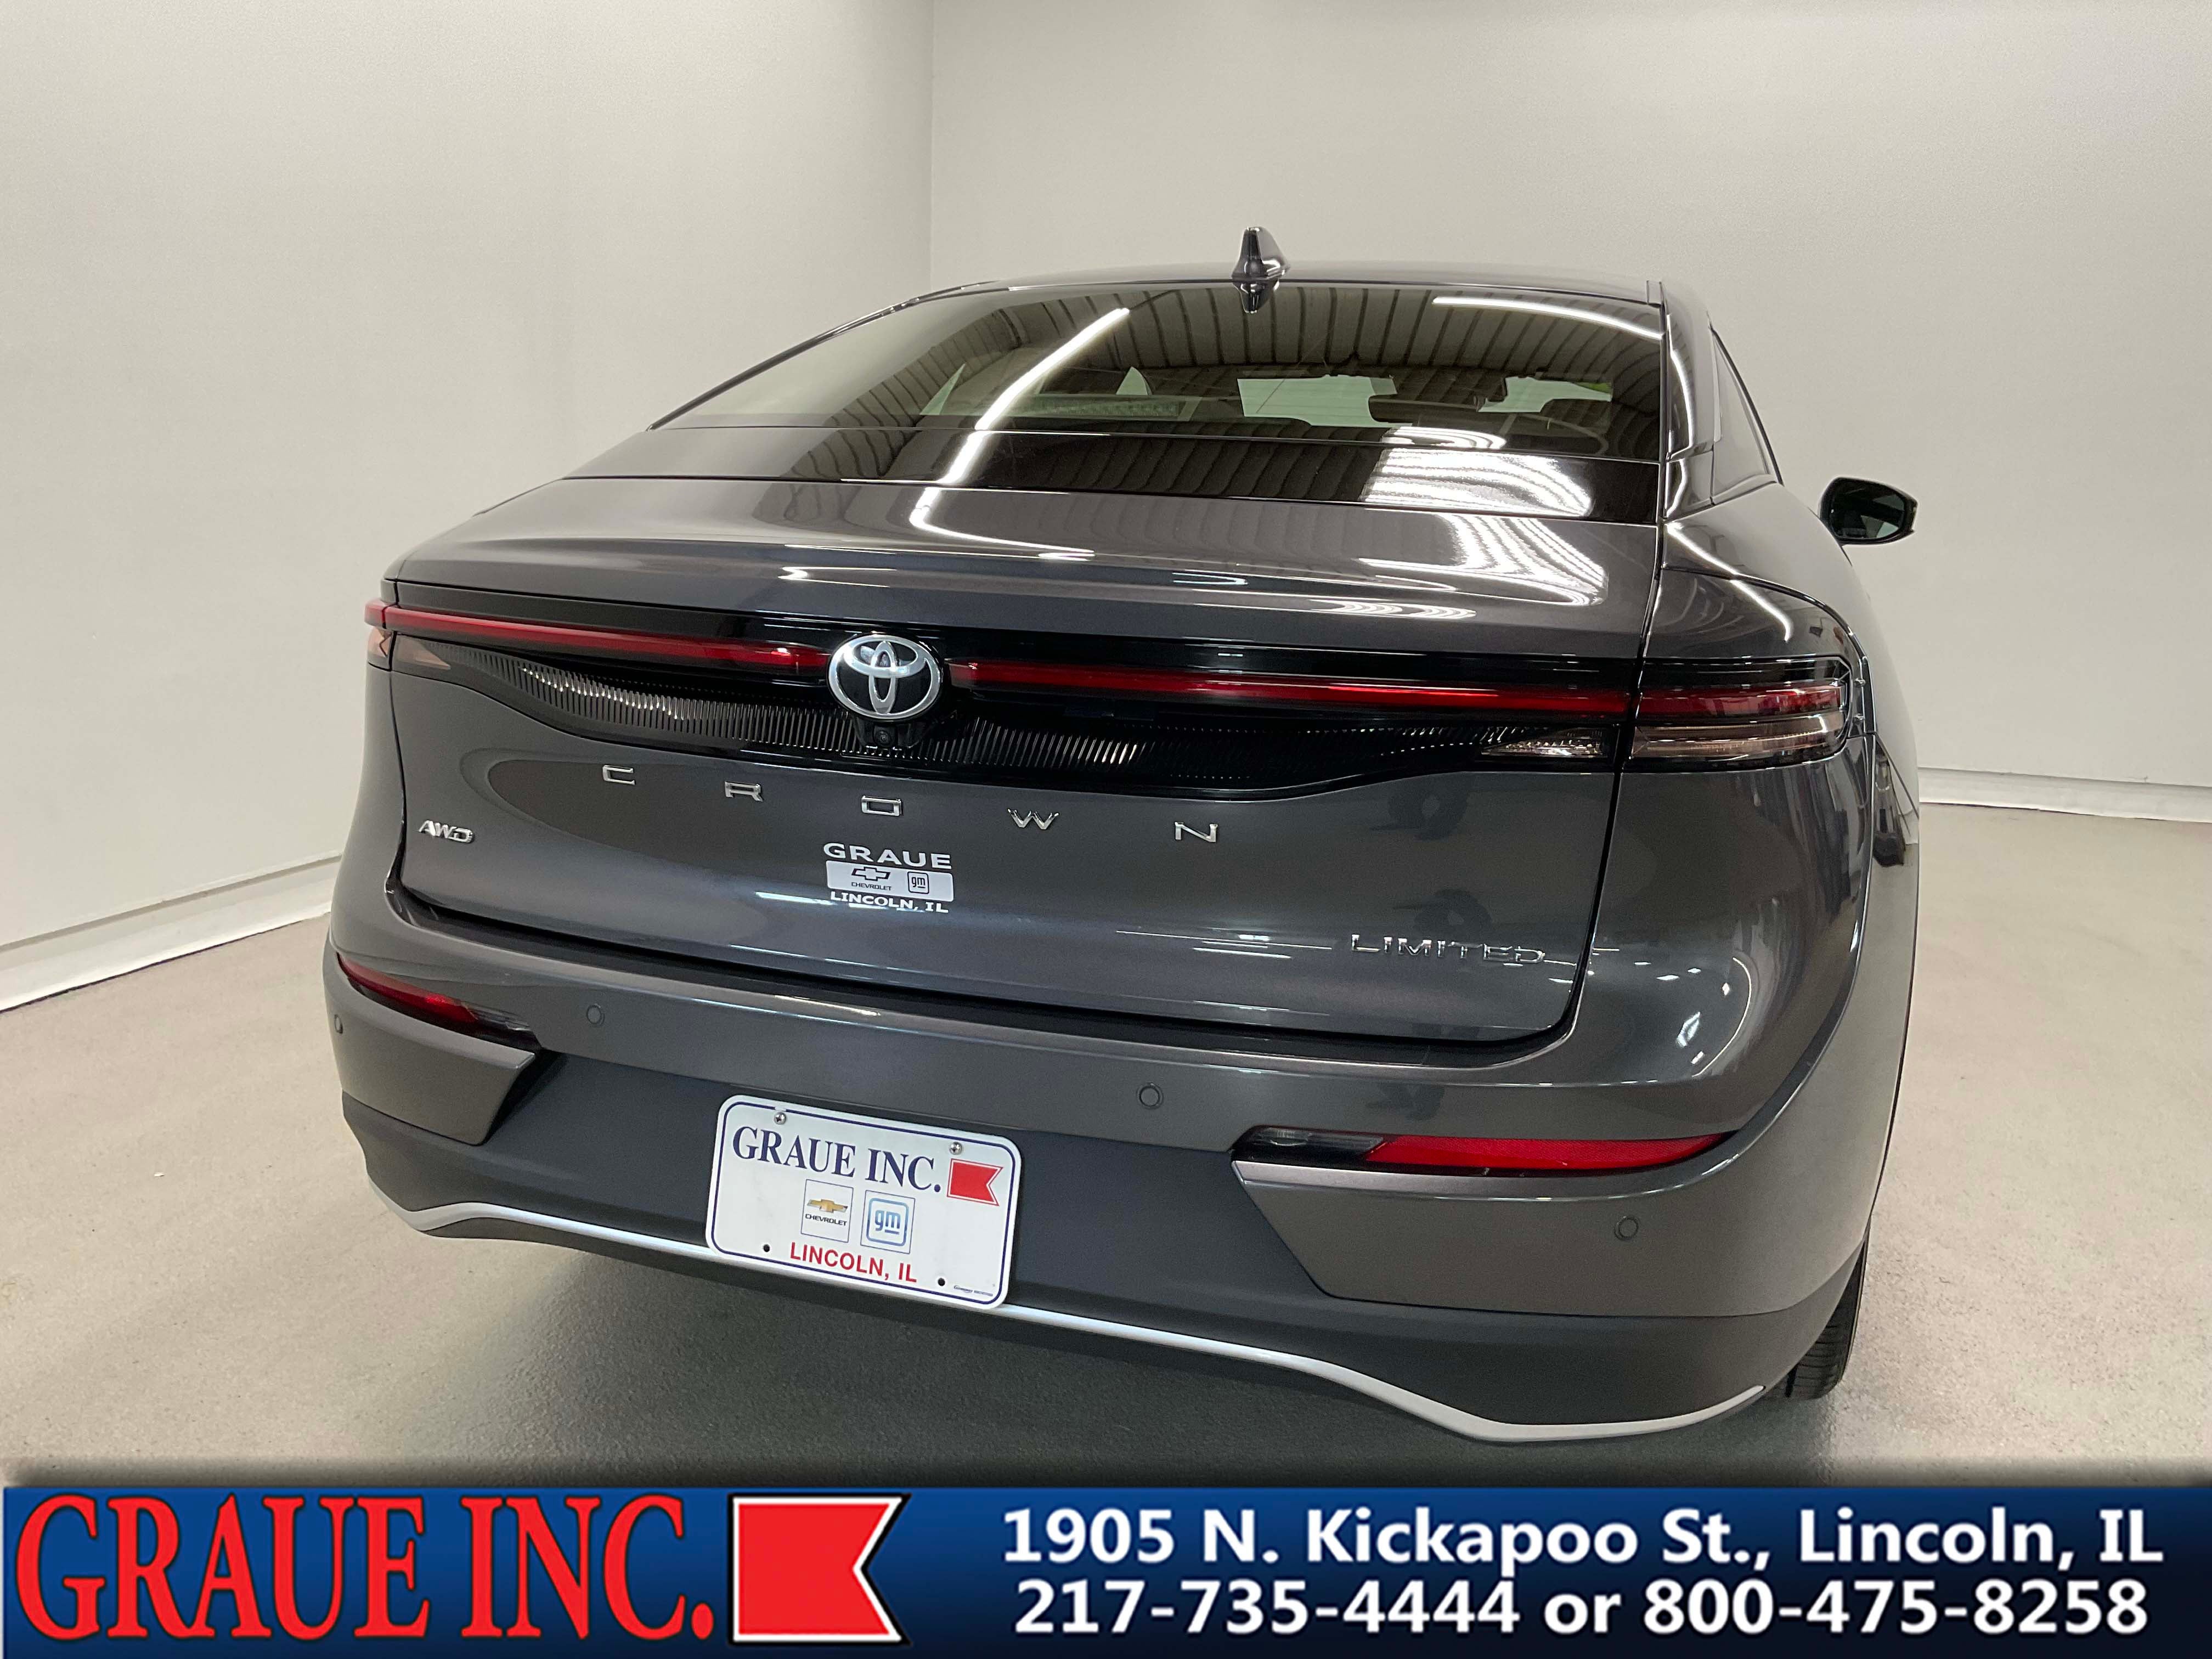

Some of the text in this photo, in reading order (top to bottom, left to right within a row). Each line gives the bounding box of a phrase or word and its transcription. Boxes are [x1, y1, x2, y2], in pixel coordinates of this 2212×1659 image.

[602, 764, 1218, 843] CROWN
[418, 820, 475, 843] AWD
[823, 842, 952, 870] GRAUE
[851, 881, 892, 891] CHEVROLET
[911, 876, 926, 889] gm
[830, 891, 949, 913] LINCOLN, IL
[1351, 933, 1546, 963] LIMITED
[732, 1125, 941, 1193] GRAUE INC.
[805, 1213, 848, 1227] CHEVROLET
[874, 1208, 901, 1235] gm
[789, 1241, 917, 1283] LINCOLN, IL
